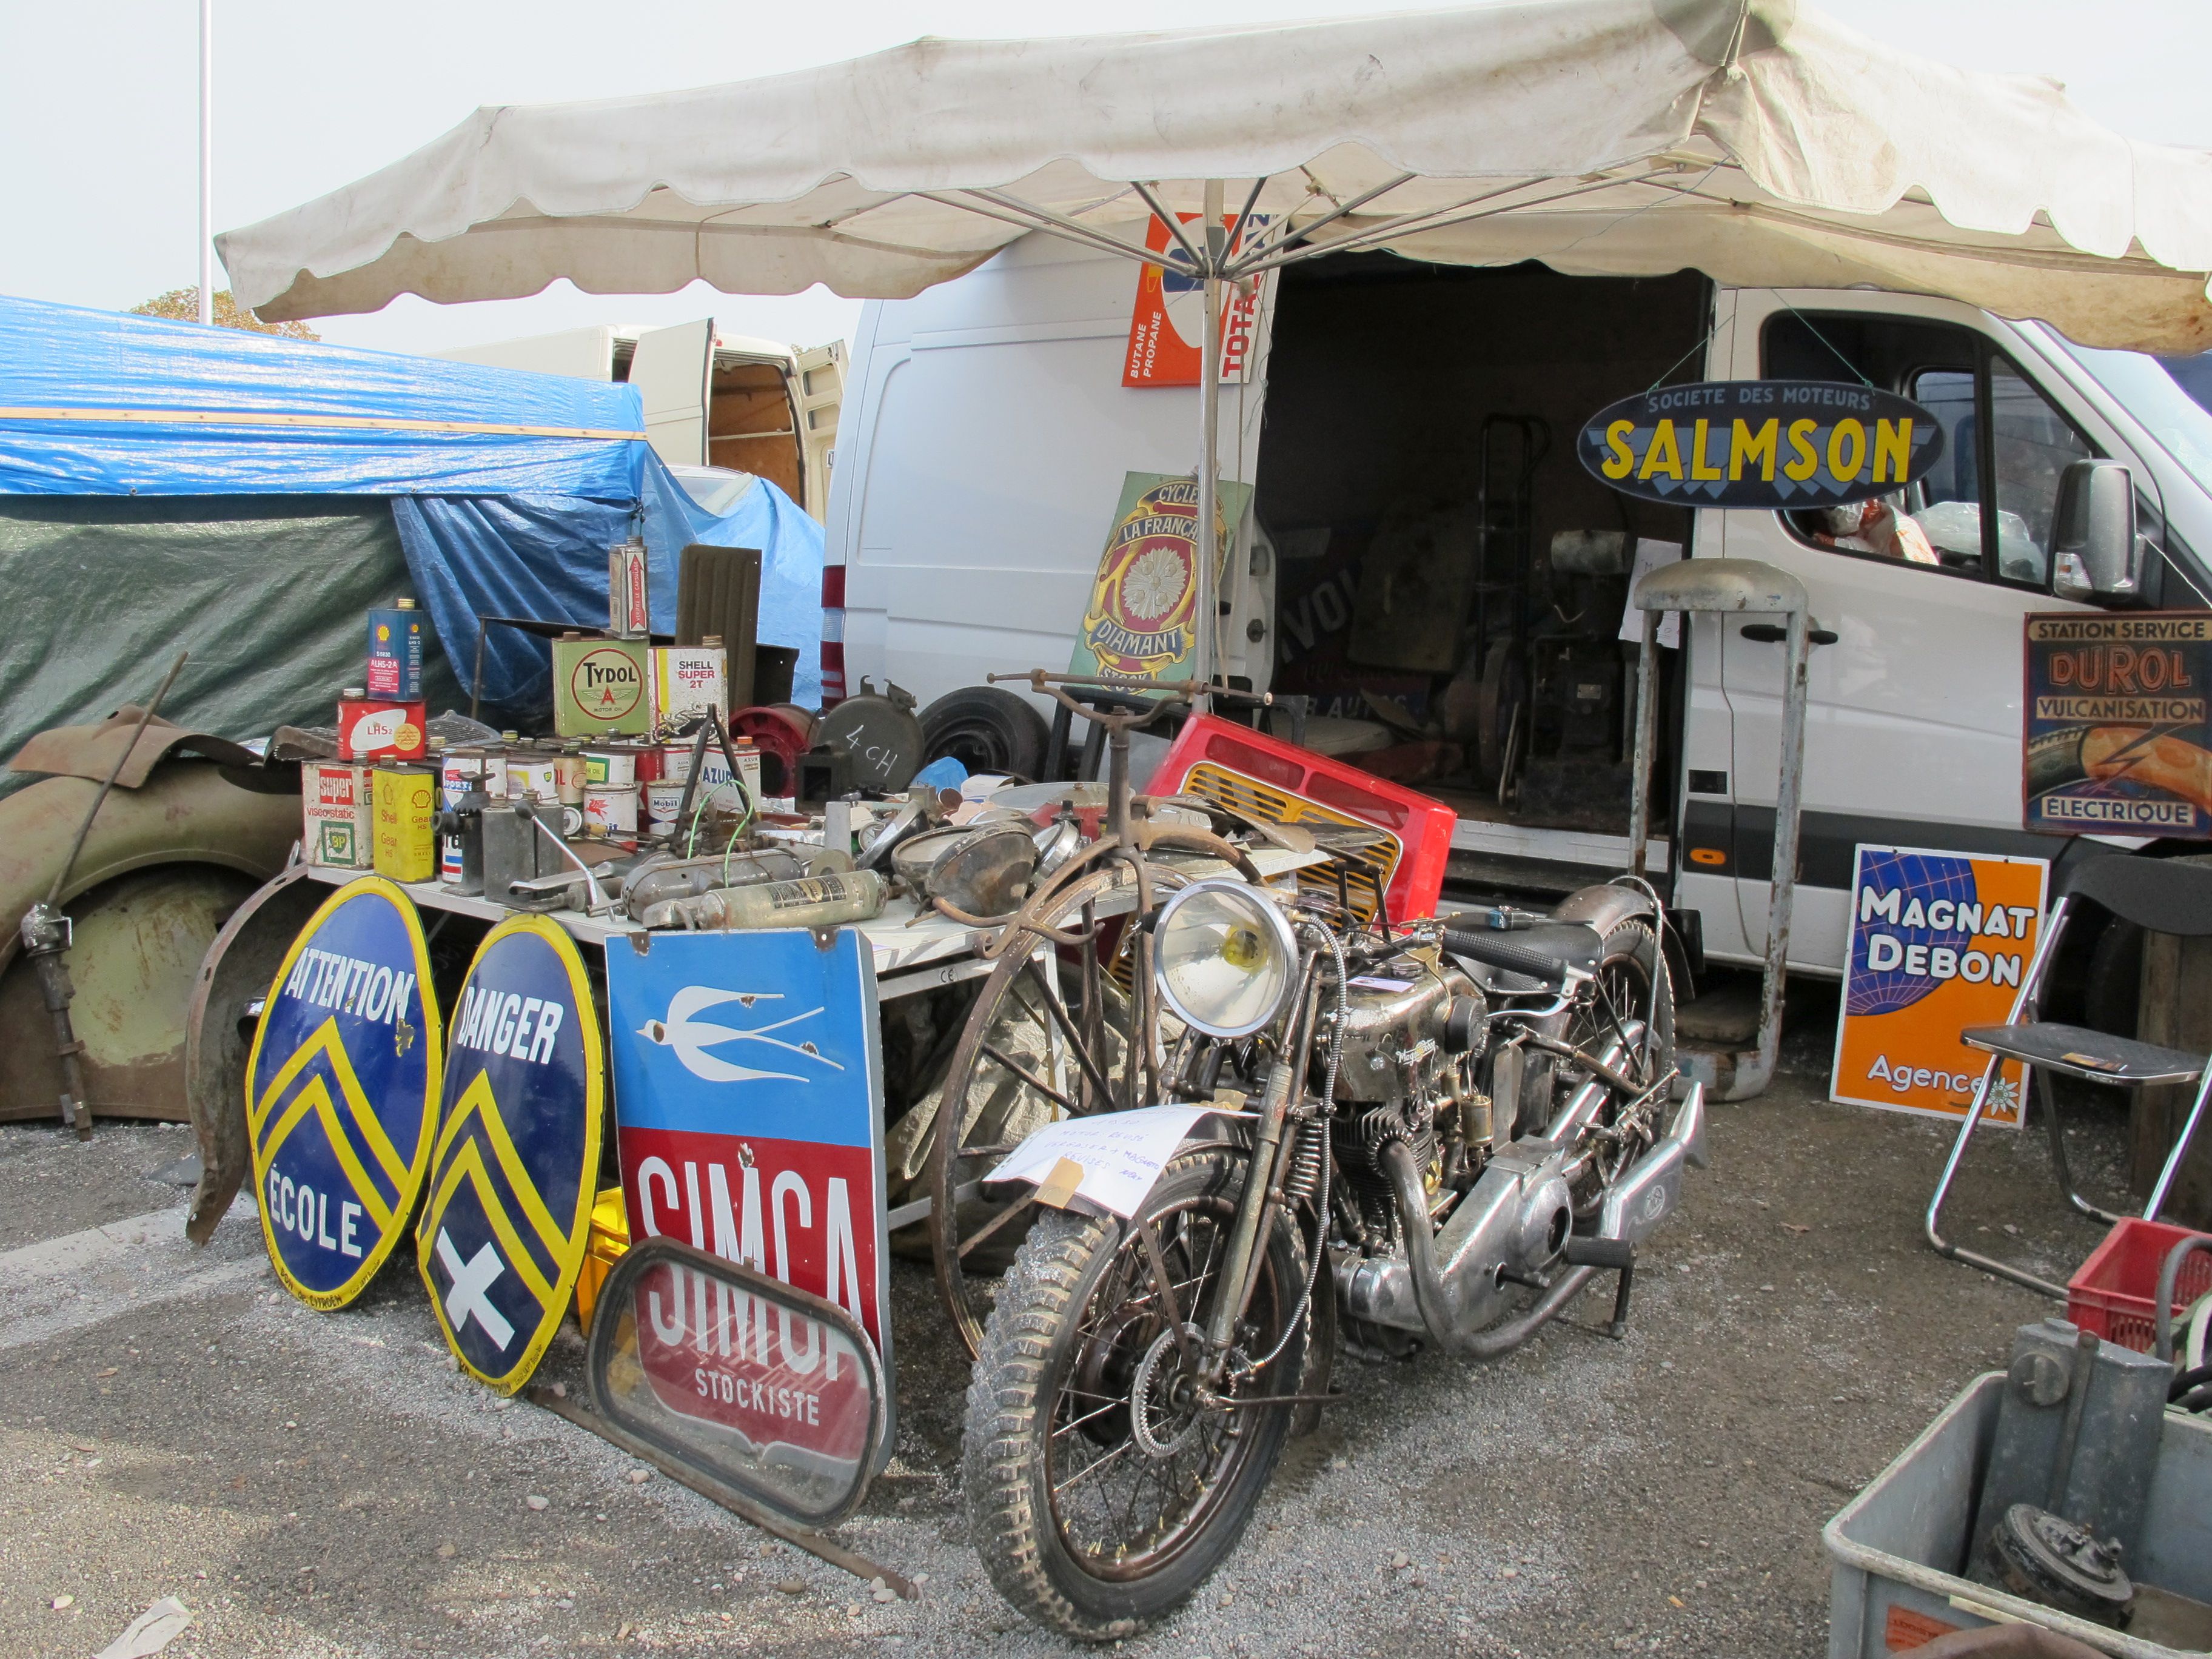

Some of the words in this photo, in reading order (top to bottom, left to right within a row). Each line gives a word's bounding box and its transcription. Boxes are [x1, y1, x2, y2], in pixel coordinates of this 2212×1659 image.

[1130, 323, 1147, 378] BUTANE
[1143, 311, 1162, 378] PROPANE
[1647, 388, 1725, 413] SOCIETE
[1738, 387, 1774, 404] DES
[1782, 388, 1871, 411] MOTEURS
[1601, 418, 1914, 483] SALMSON
[1124, 522, 1141, 541] LA
[1096, 620, 1179, 655] DIAMANT
[2038, 622, 2117, 639] STATION
[2123, 622, 2205, 638] SERVICE
[583, 662, 637, 688] TYDOL
[678, 670, 716, 679] SUPER
[679, 661, 714, 669] SHELL
[2049, 643, 2191, 695] DUROL
[689, 680, 704, 689] 2T
[2038, 699, 2204, 719] VULCANISATION
[846, 725, 864, 749] 4
[866, 746, 899, 777] CH
[320, 777, 353, 803] super
[703, 766, 734, 788] AZUR
[653, 796, 678, 806] Mobil
[381, 809, 398, 825] Shell
[332, 836, 346, 846] BP
[381, 833, 398, 846] Gear
[1860, 885, 2037, 939] MAGNAT
[1868, 934, 2022, 988] DEBON
[284, 947, 415, 1026] ATTENTION
[457, 985, 565, 1065] DANGER
[1868, 1054, 1982, 1093] Agence
[638, 1156, 867, 1389] SIMCA
[695, 1367, 821, 1427] STOCKISTE
